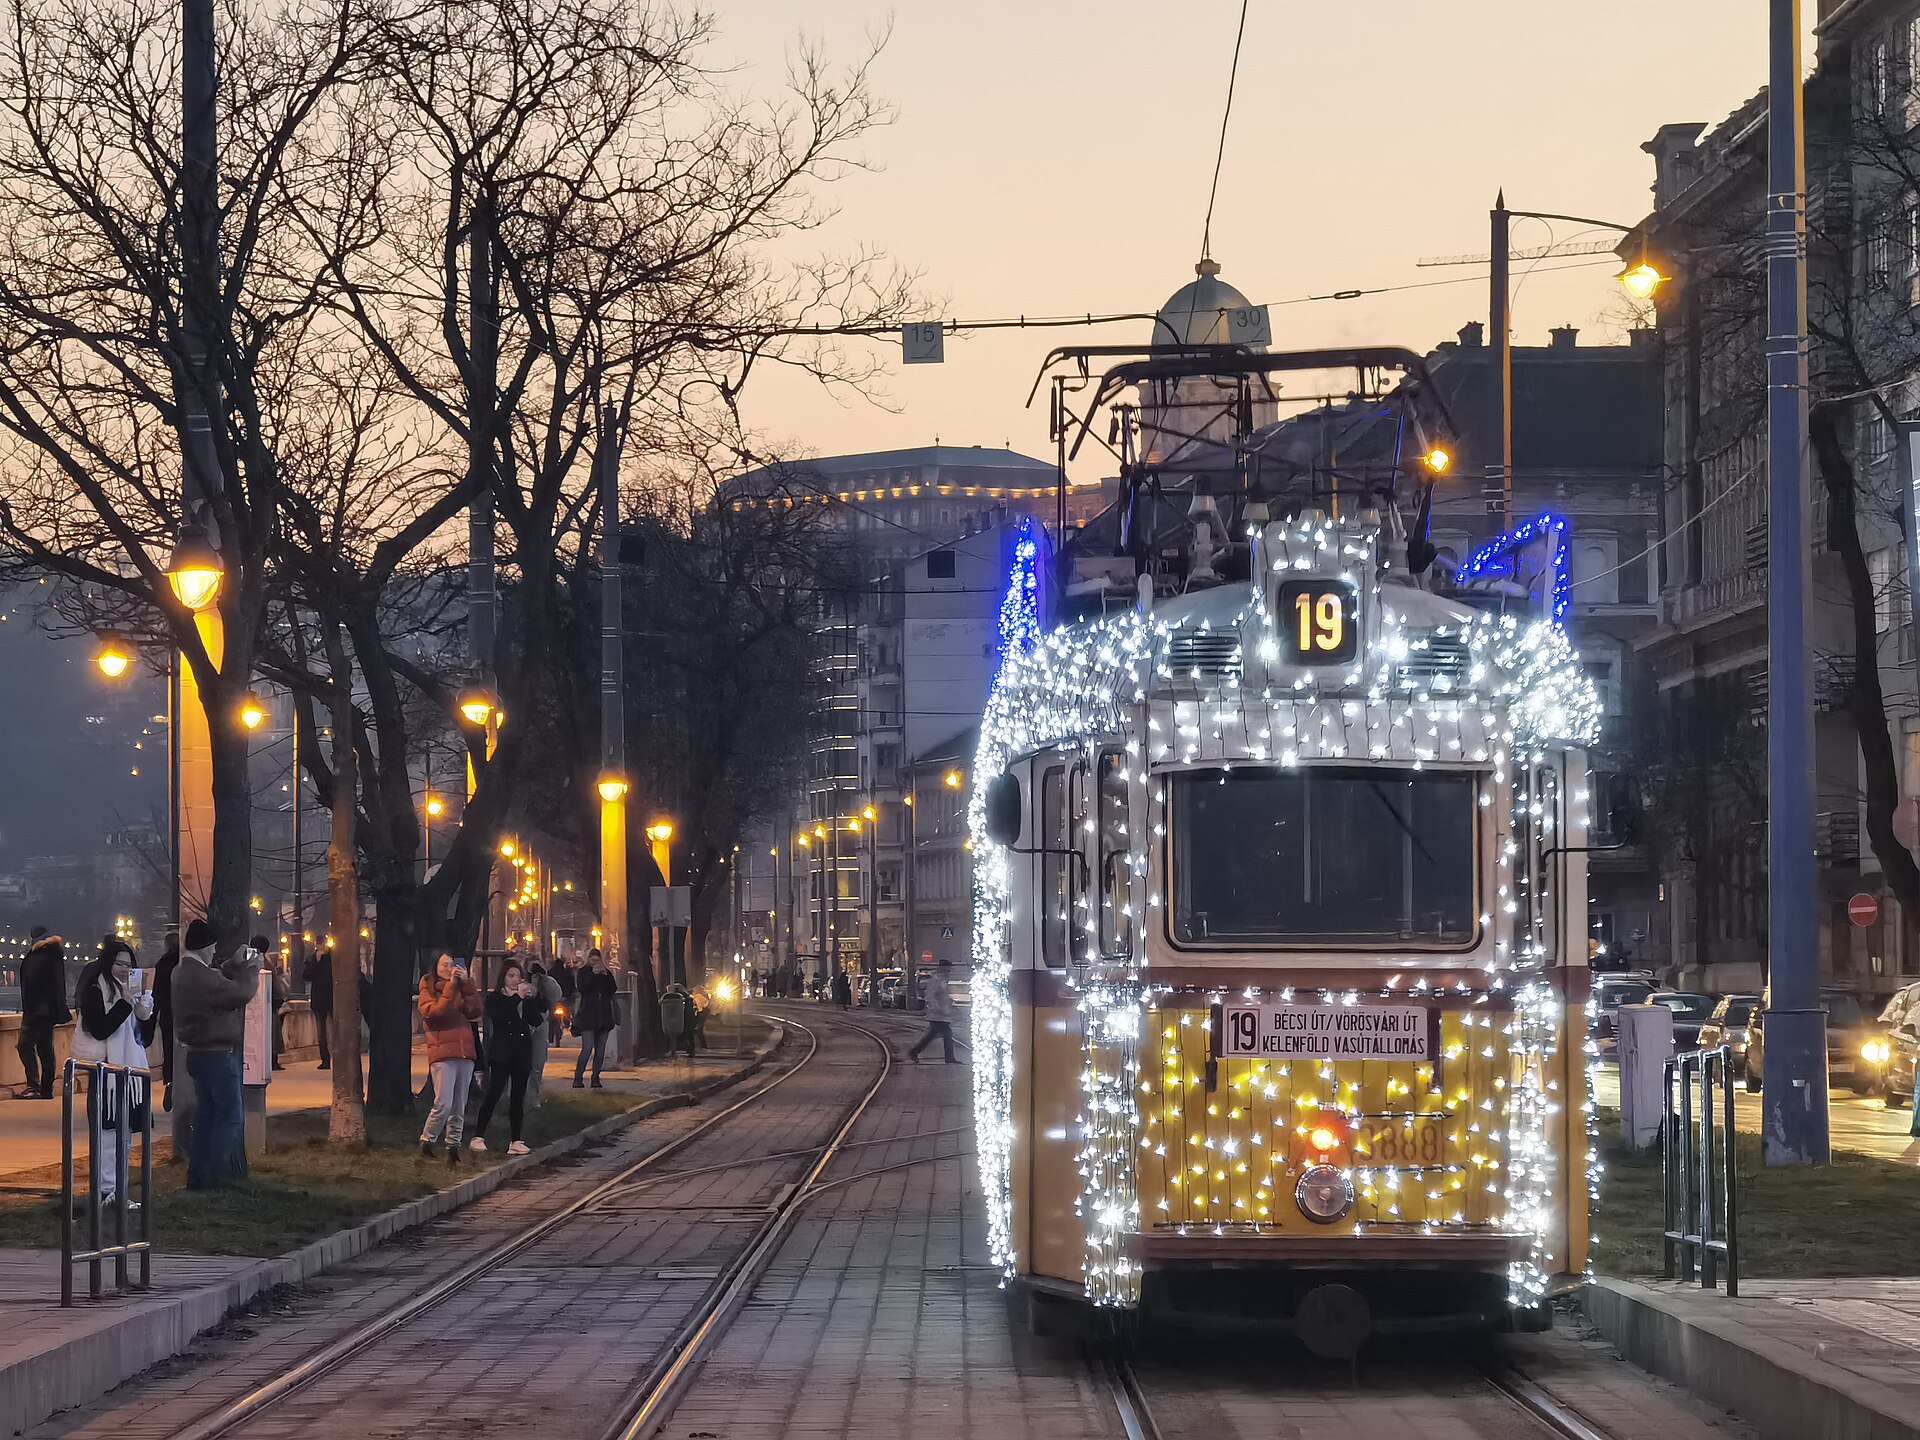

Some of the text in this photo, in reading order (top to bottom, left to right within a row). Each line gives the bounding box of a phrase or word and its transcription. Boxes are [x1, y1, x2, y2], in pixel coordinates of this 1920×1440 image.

[1236, 308, 1261, 328] 30
[911, 325, 935, 343] 15
[1295, 592, 1343, 651] 19
[1230, 1012, 1256, 1051] 19
[1274, 1009, 1307, 1030] BÉCSI
[1403, 1010, 1419, 1032] ÚT
[1262, 1033, 1425, 1055] KELENFÖLD VASÚTÁLLOMÁS
